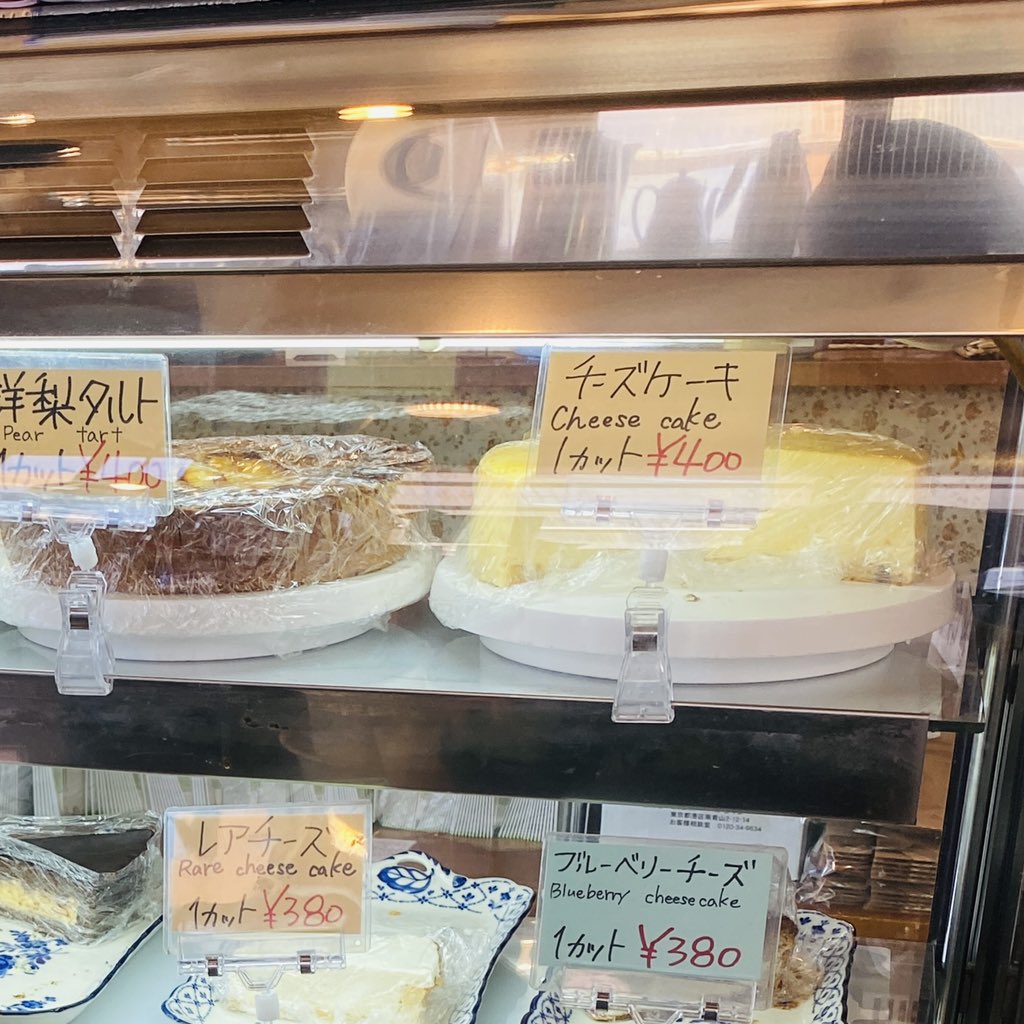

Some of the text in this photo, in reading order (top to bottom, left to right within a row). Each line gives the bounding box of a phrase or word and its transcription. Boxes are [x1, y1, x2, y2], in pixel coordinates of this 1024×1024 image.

[566, 355, 739, 401] チーズケーキ
[3, 425, 123, 443] Pear tart
[551, 397, 721, 432] Cheese cake
[79, 440, 162, 493] ¥400
[553, 432, 742, 477] 1カット ¥400
[199, 815, 331, 857] レアチーズ
[178, 851, 357, 878] Rare cheese cake
[554, 850, 756, 887] ブルーベリーチーズ
[189, 884, 343, 930] 1カット ¥380
[550, 883, 631, 906] Blueberry
[553, 924, 742, 969] 1カット ¥380
